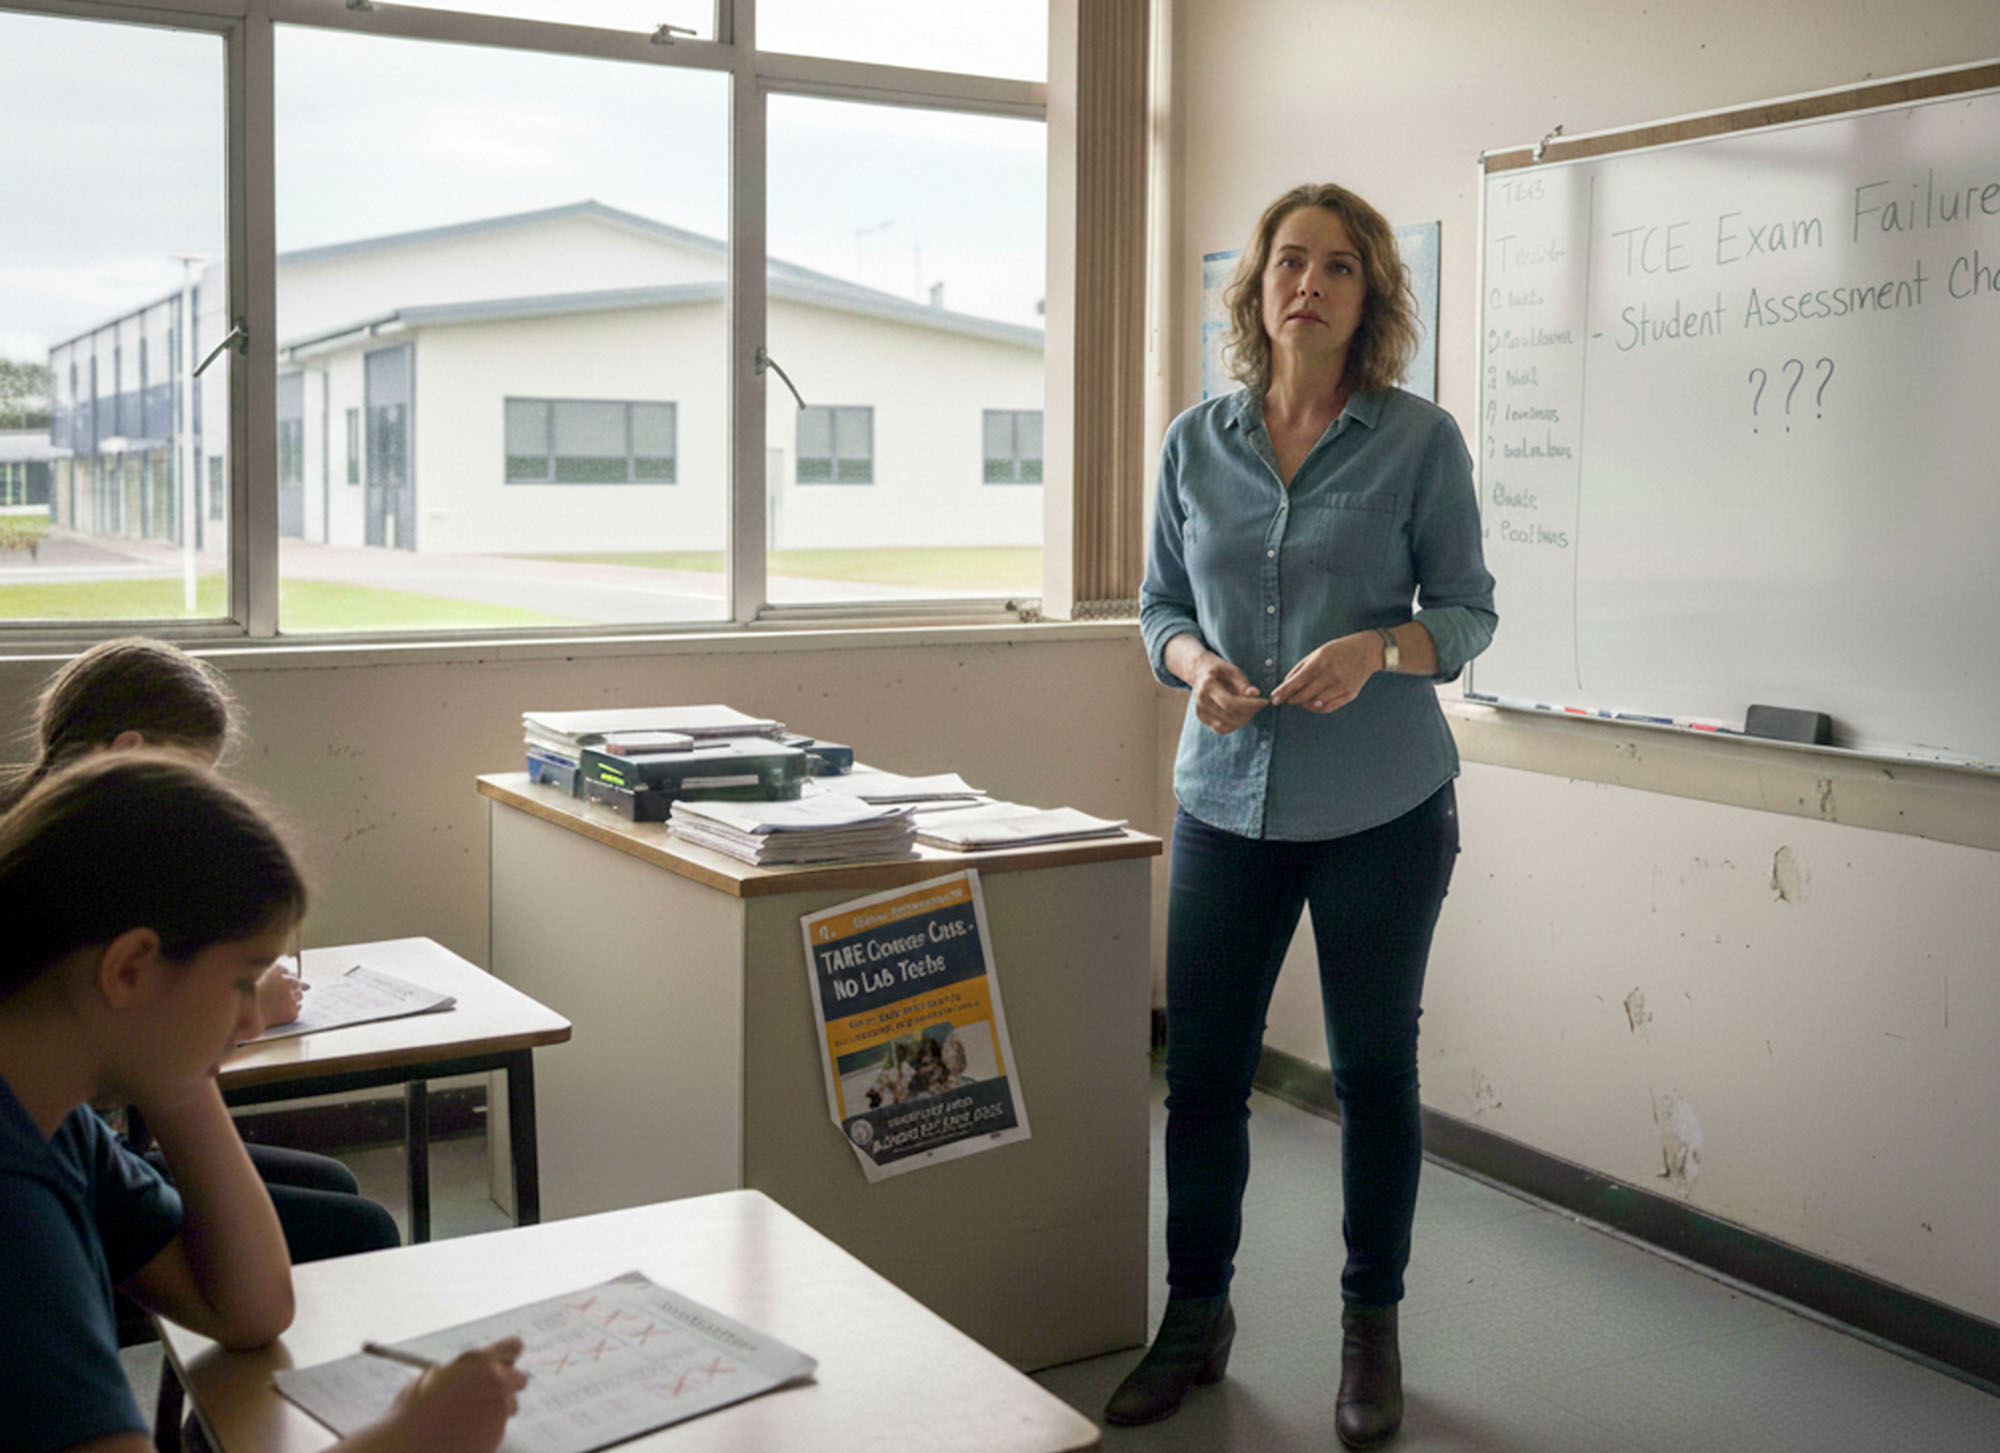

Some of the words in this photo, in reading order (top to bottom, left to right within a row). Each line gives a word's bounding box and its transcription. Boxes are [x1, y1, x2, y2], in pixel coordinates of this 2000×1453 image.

[1611, 221, 1690, 277] TCE
[1715, 212, 1823, 266] Exam
[1854, 168, 2000, 242] Failure
[1615, 292, 1727, 351] Student
[1744, 259, 1929, 329] Assessment
